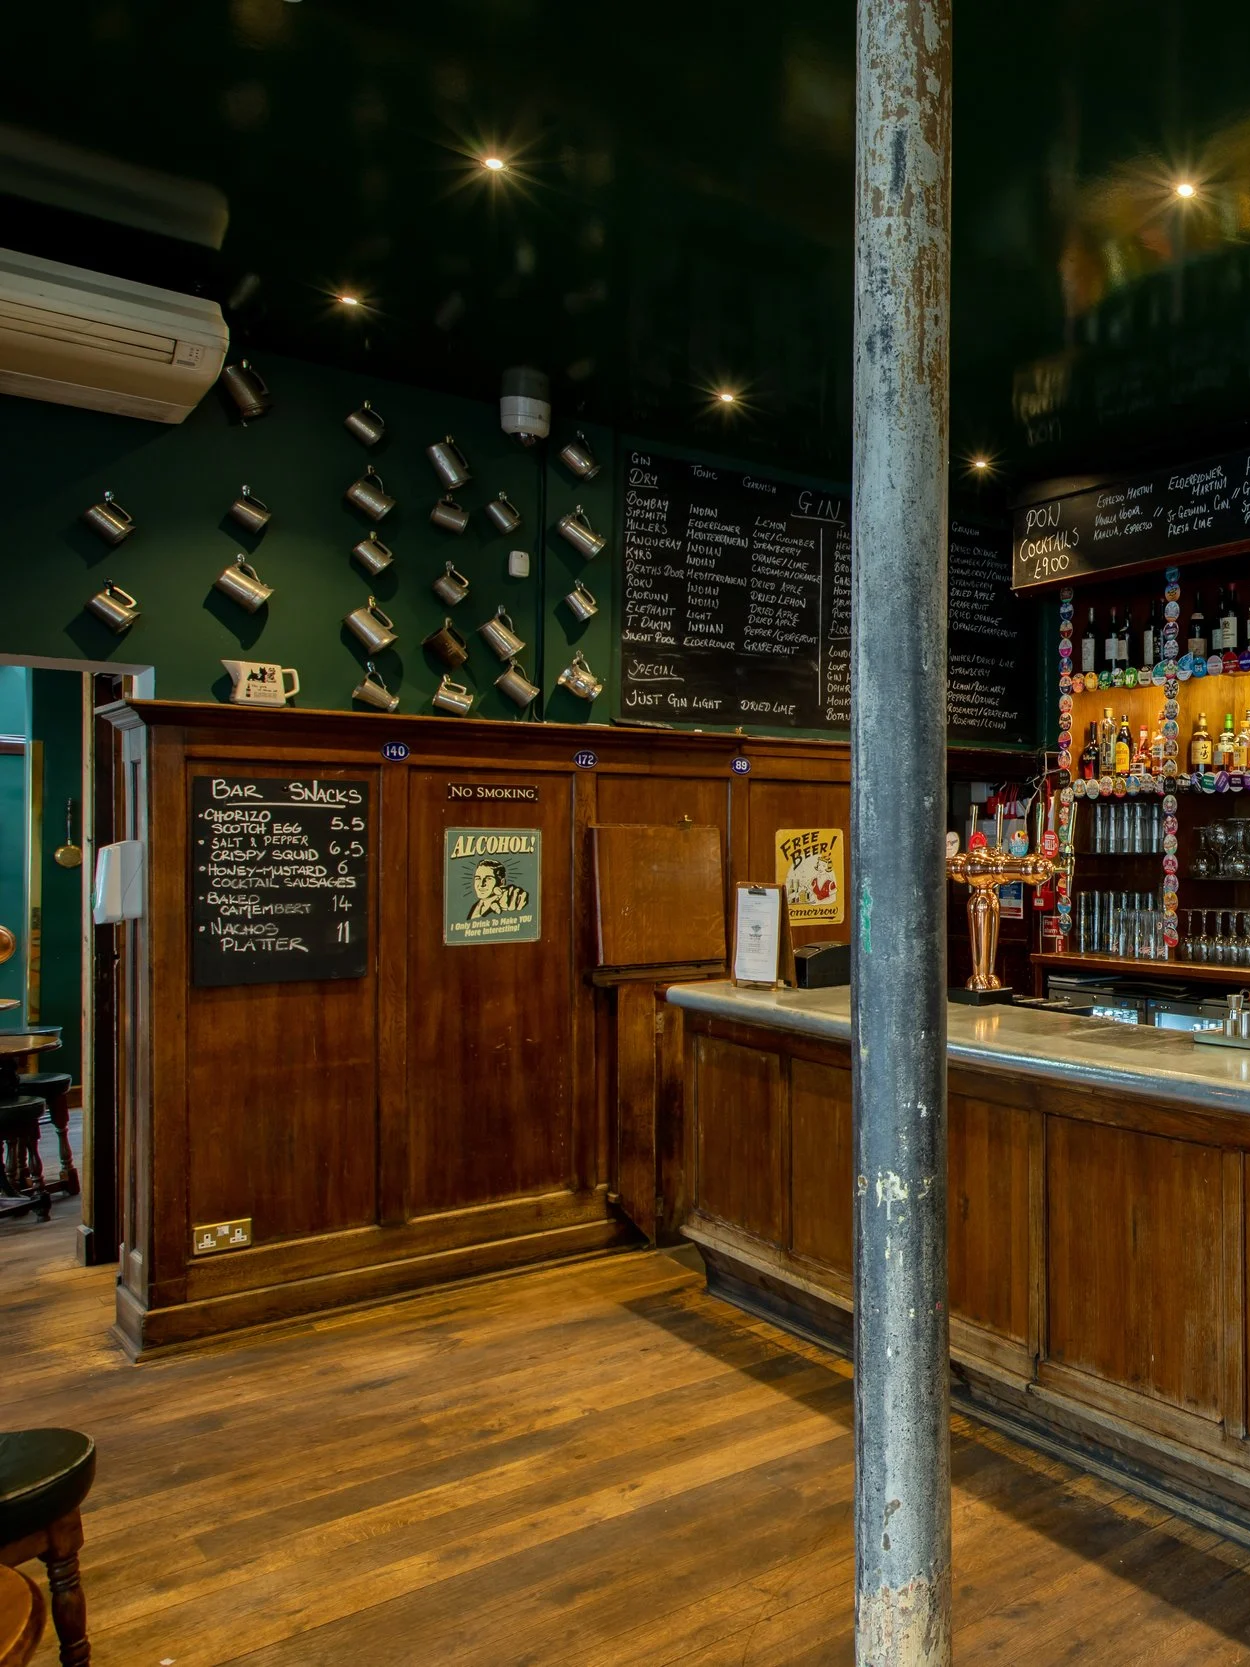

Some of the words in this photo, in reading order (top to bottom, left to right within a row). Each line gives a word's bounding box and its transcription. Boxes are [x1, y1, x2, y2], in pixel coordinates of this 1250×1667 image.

[626, 490, 669, 512] BOMBAY
[799, 491, 840, 520] GIN
[624, 531, 681, 550] TANQUERAY
[1020, 527, 1080, 562] COCKTAILS
[627, 574, 652, 588] ROKU
[626, 601, 676, 616] ELEPHANT
[628, 659, 678, 677] SPECIAL
[668, 693, 687, 708] GIN
[693, 699, 722, 709] LIGHT
[741, 699, 770, 712] DRIED
[386, 745, 405, 757] 140
[577, 753, 594, 765] 172
[735, 761, 747, 771] 89
[212, 779, 263, 799] BAR
[288, 780, 362, 804] SNACKS
[204, 809, 271, 823] CHORIZO
[211, 823, 266, 834] SCOTCH
[273, 823, 302, 834] EGG
[331, 817, 364, 831] 5.5
[211, 837, 243, 848] SALT
[264, 835, 309, 846] PEPPER
[329, 841, 364, 857] 6.5
[451, 836, 536, 860] ALCOHOL!
[780, 831, 819, 861] FREE
[790, 836, 837, 870] BEER!
[211, 850, 266, 862] CRISPY
[272, 849, 319, 860] SQUID
[208, 865, 327, 878] HONEY-MUSTARD
[337, 860, 348, 874] 6
[212, 878, 279, 889] COCKTAIL
[284, 877, 356, 888] SAUSAGES
[208, 892, 260, 904] BAKED
[220, 904, 311, 918] CAMEMBERT
[332, 895, 352, 912] 14
[210, 917, 279, 936] NACHOS
[337, 921, 349, 943] 11
[456, 923, 470, 931] Only
[472, 920, 490, 929] Drink
[501, 917, 517, 925] Make
[519, 915, 532, 923] YOU
[465, 928, 481, 937] More
[483, 924, 520, 935] Interesting!
[221, 937, 309, 952] PLATTER
